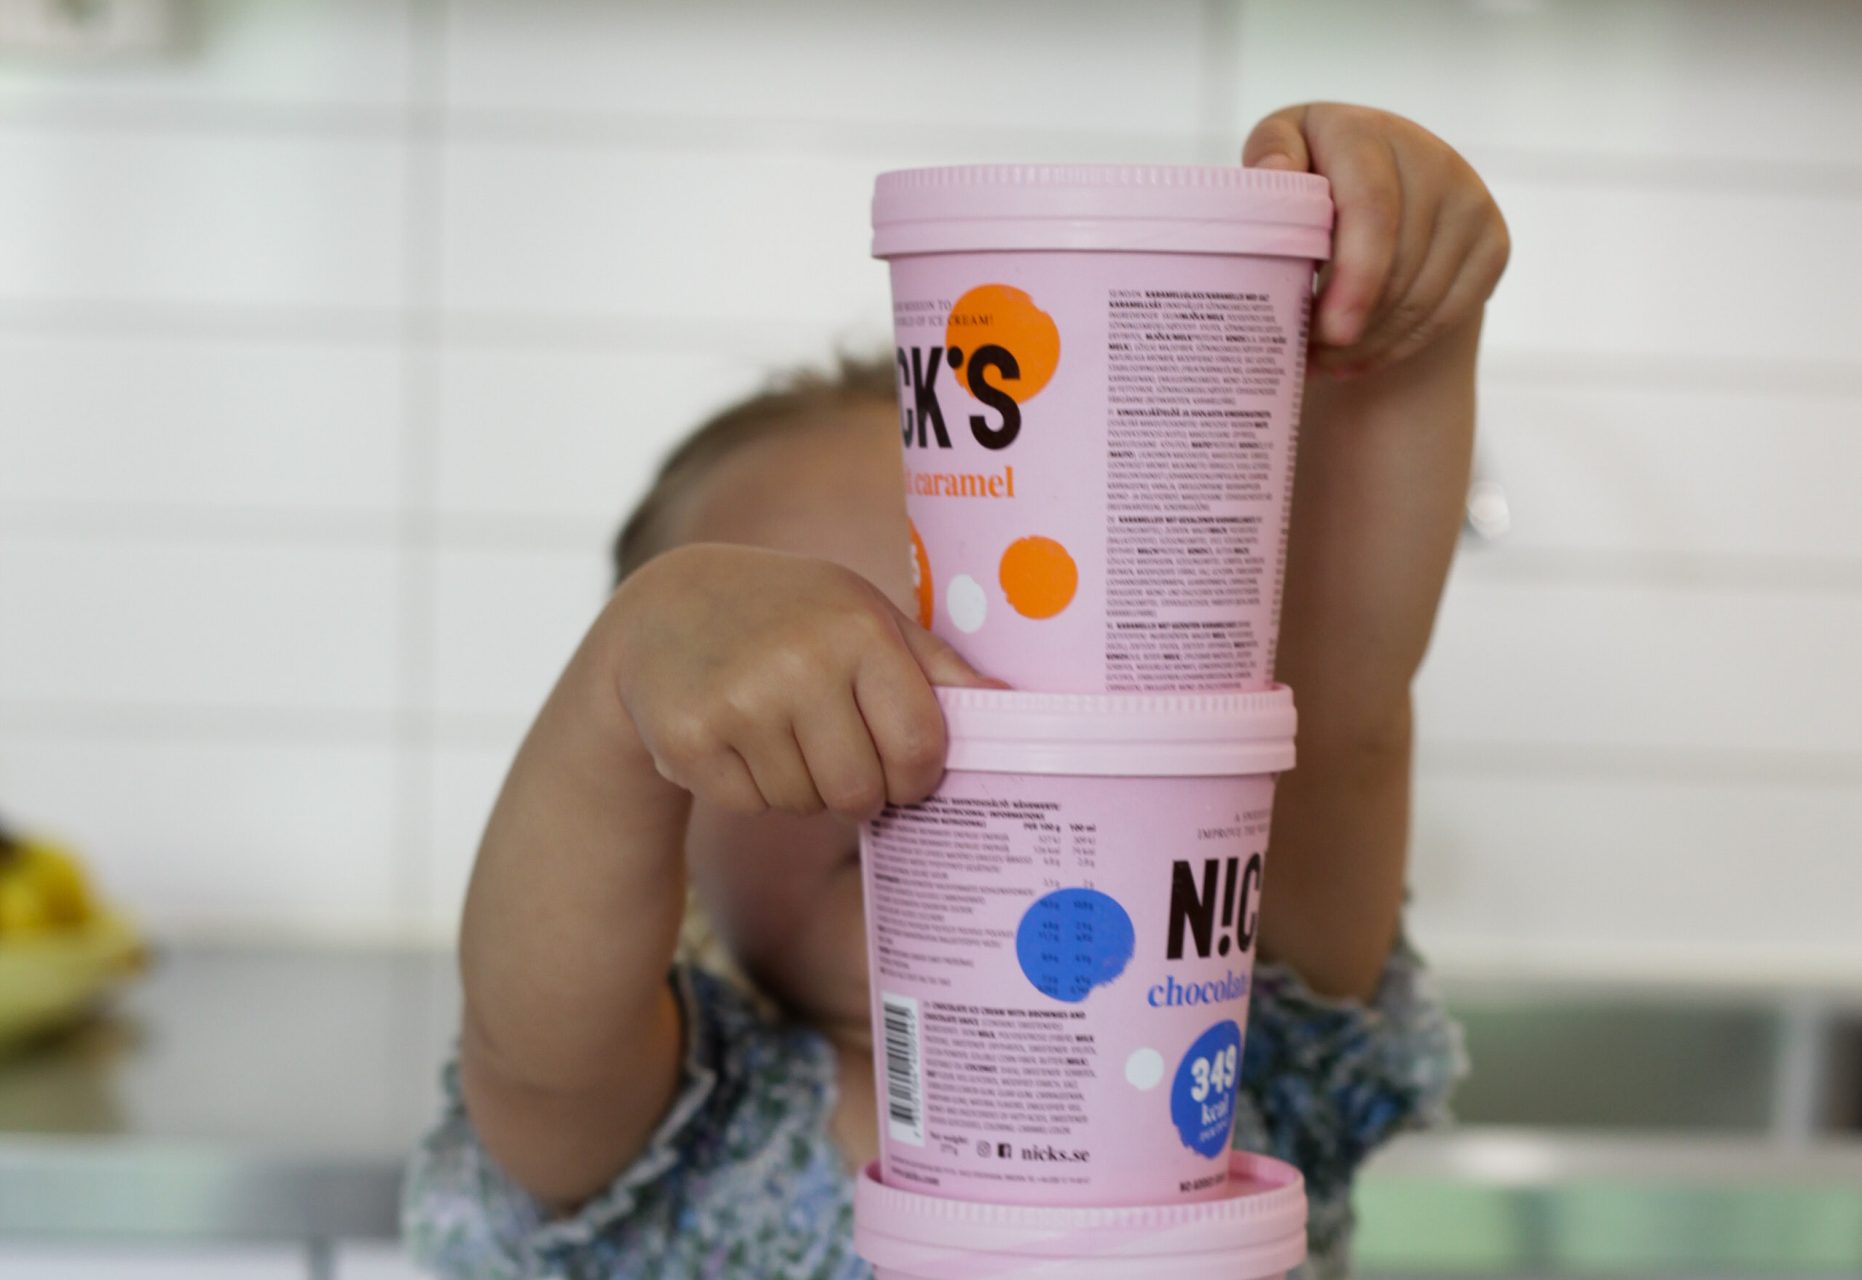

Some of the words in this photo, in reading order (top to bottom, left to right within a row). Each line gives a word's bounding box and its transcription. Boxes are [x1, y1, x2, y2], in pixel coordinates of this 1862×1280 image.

[898, 343, 1022, 451] CK'S
[914, 464, 1015, 498] caramel
[1166, 852, 1261, 960] N!C
[1191, 1044, 1237, 1103] 349
[1021, 1145, 1091, 1163] nicks.se
